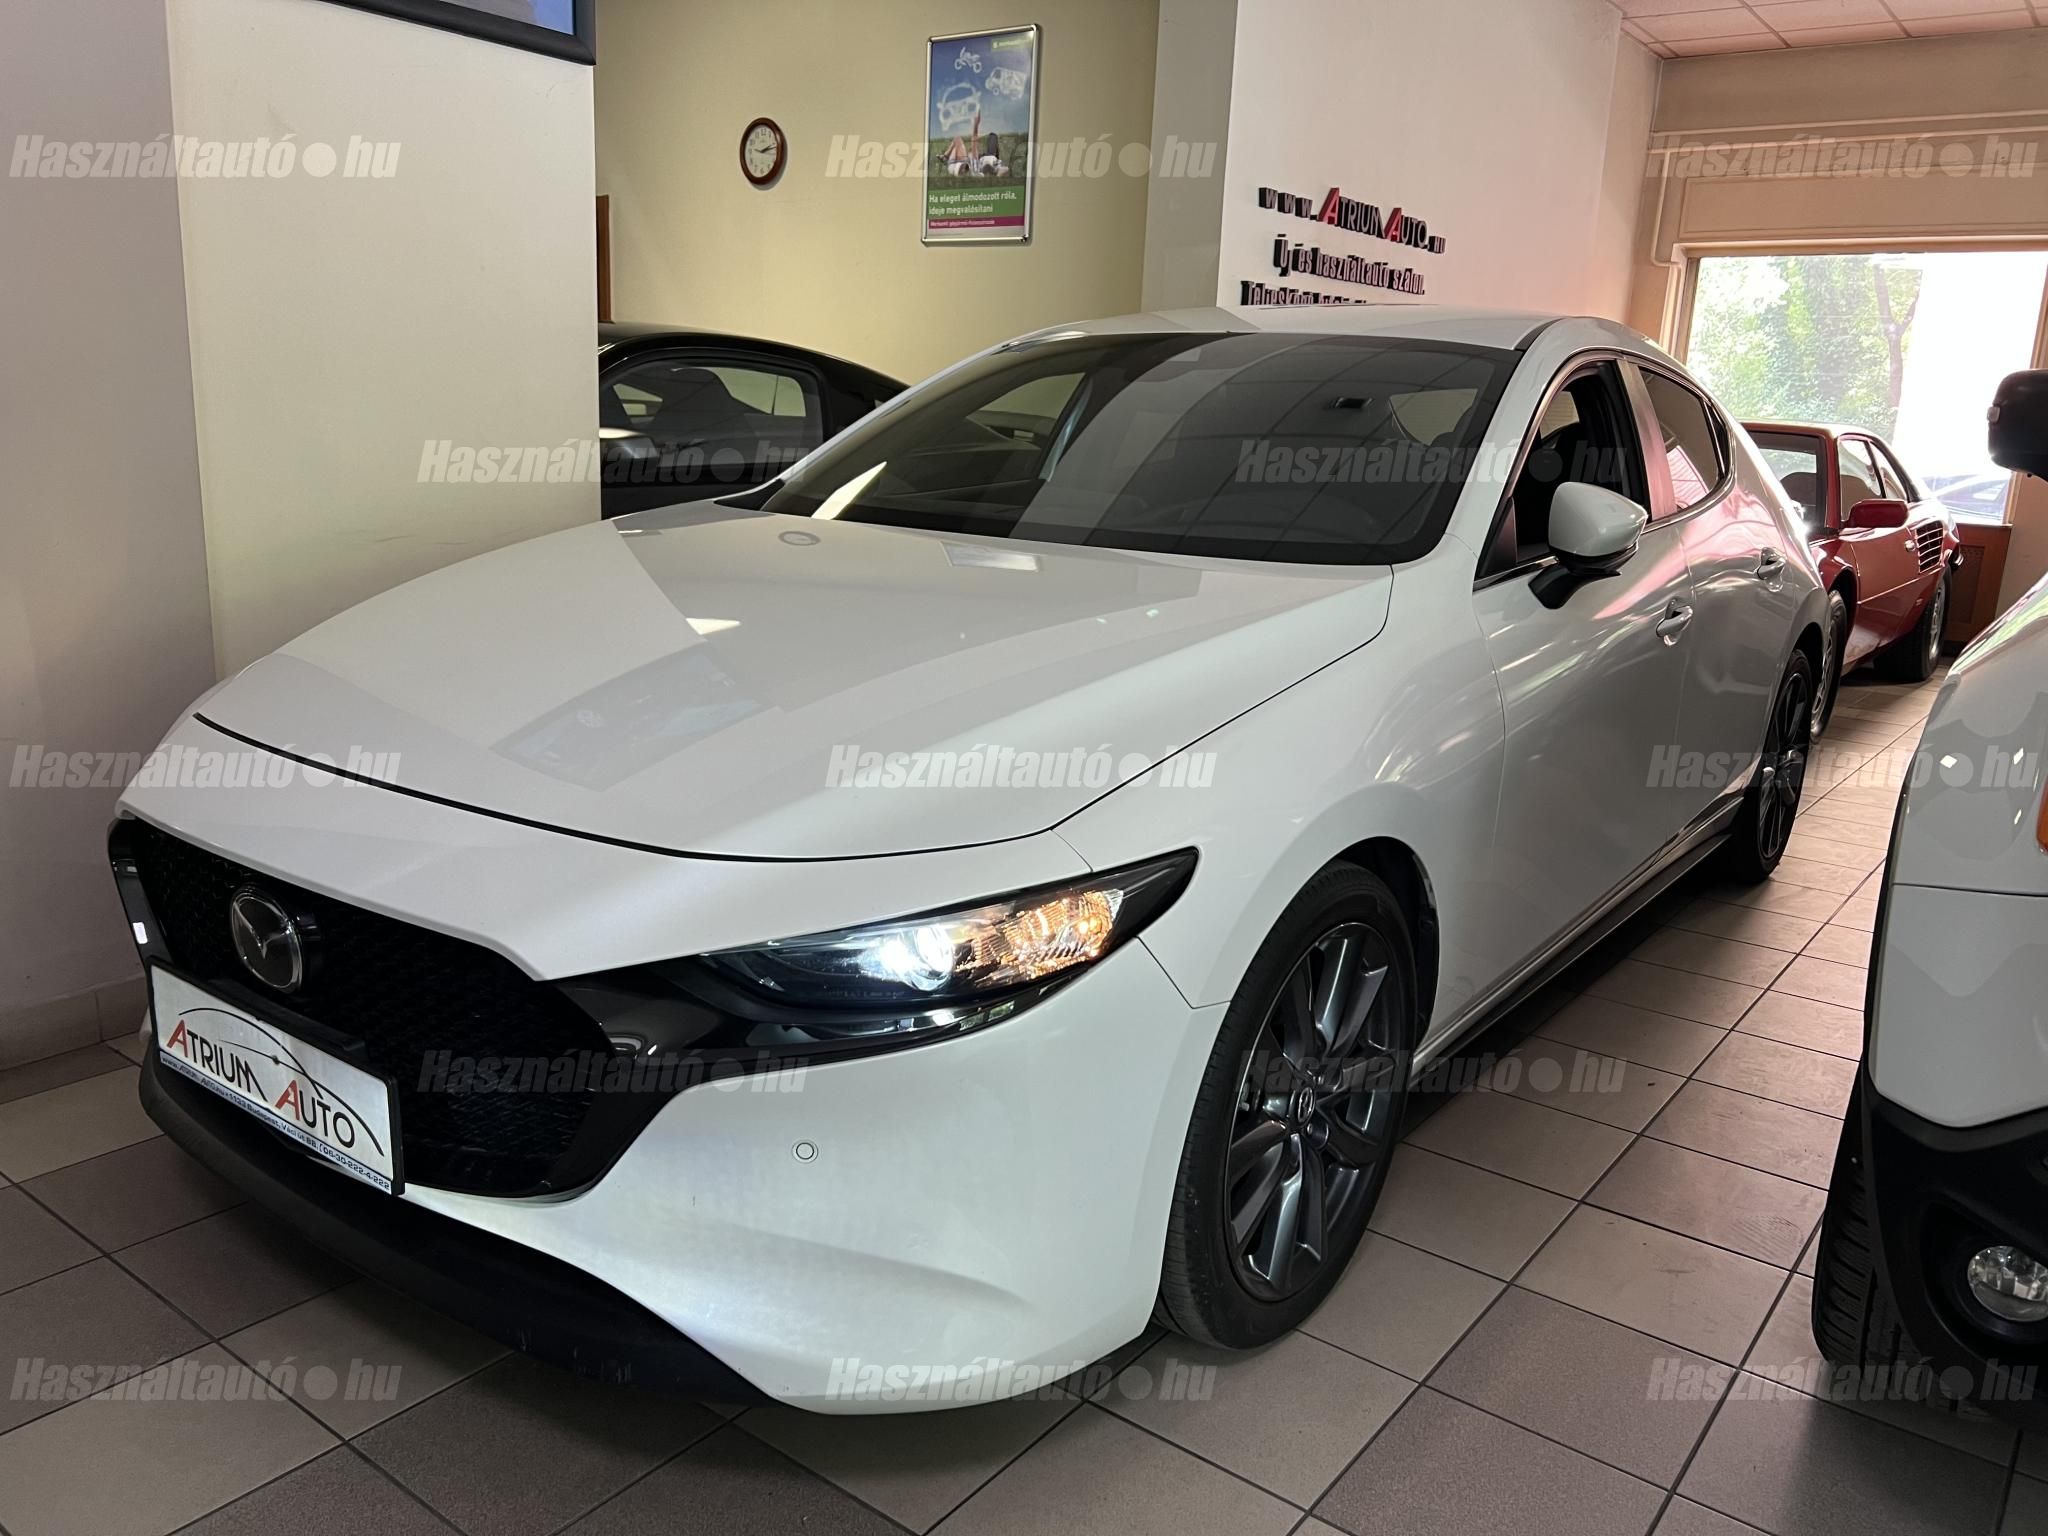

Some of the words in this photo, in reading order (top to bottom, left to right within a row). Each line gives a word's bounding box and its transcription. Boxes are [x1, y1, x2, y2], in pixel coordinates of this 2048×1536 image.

[929, 194, 938, 203] Ha
[1273, 233, 1290, 277] Új
[1291, 243, 1312, 274] és
[1312, 247, 1390, 288] használtautó
[166, 1019, 268, 1103] ATRIUM
[275, 1080, 356, 1149] AUTO
